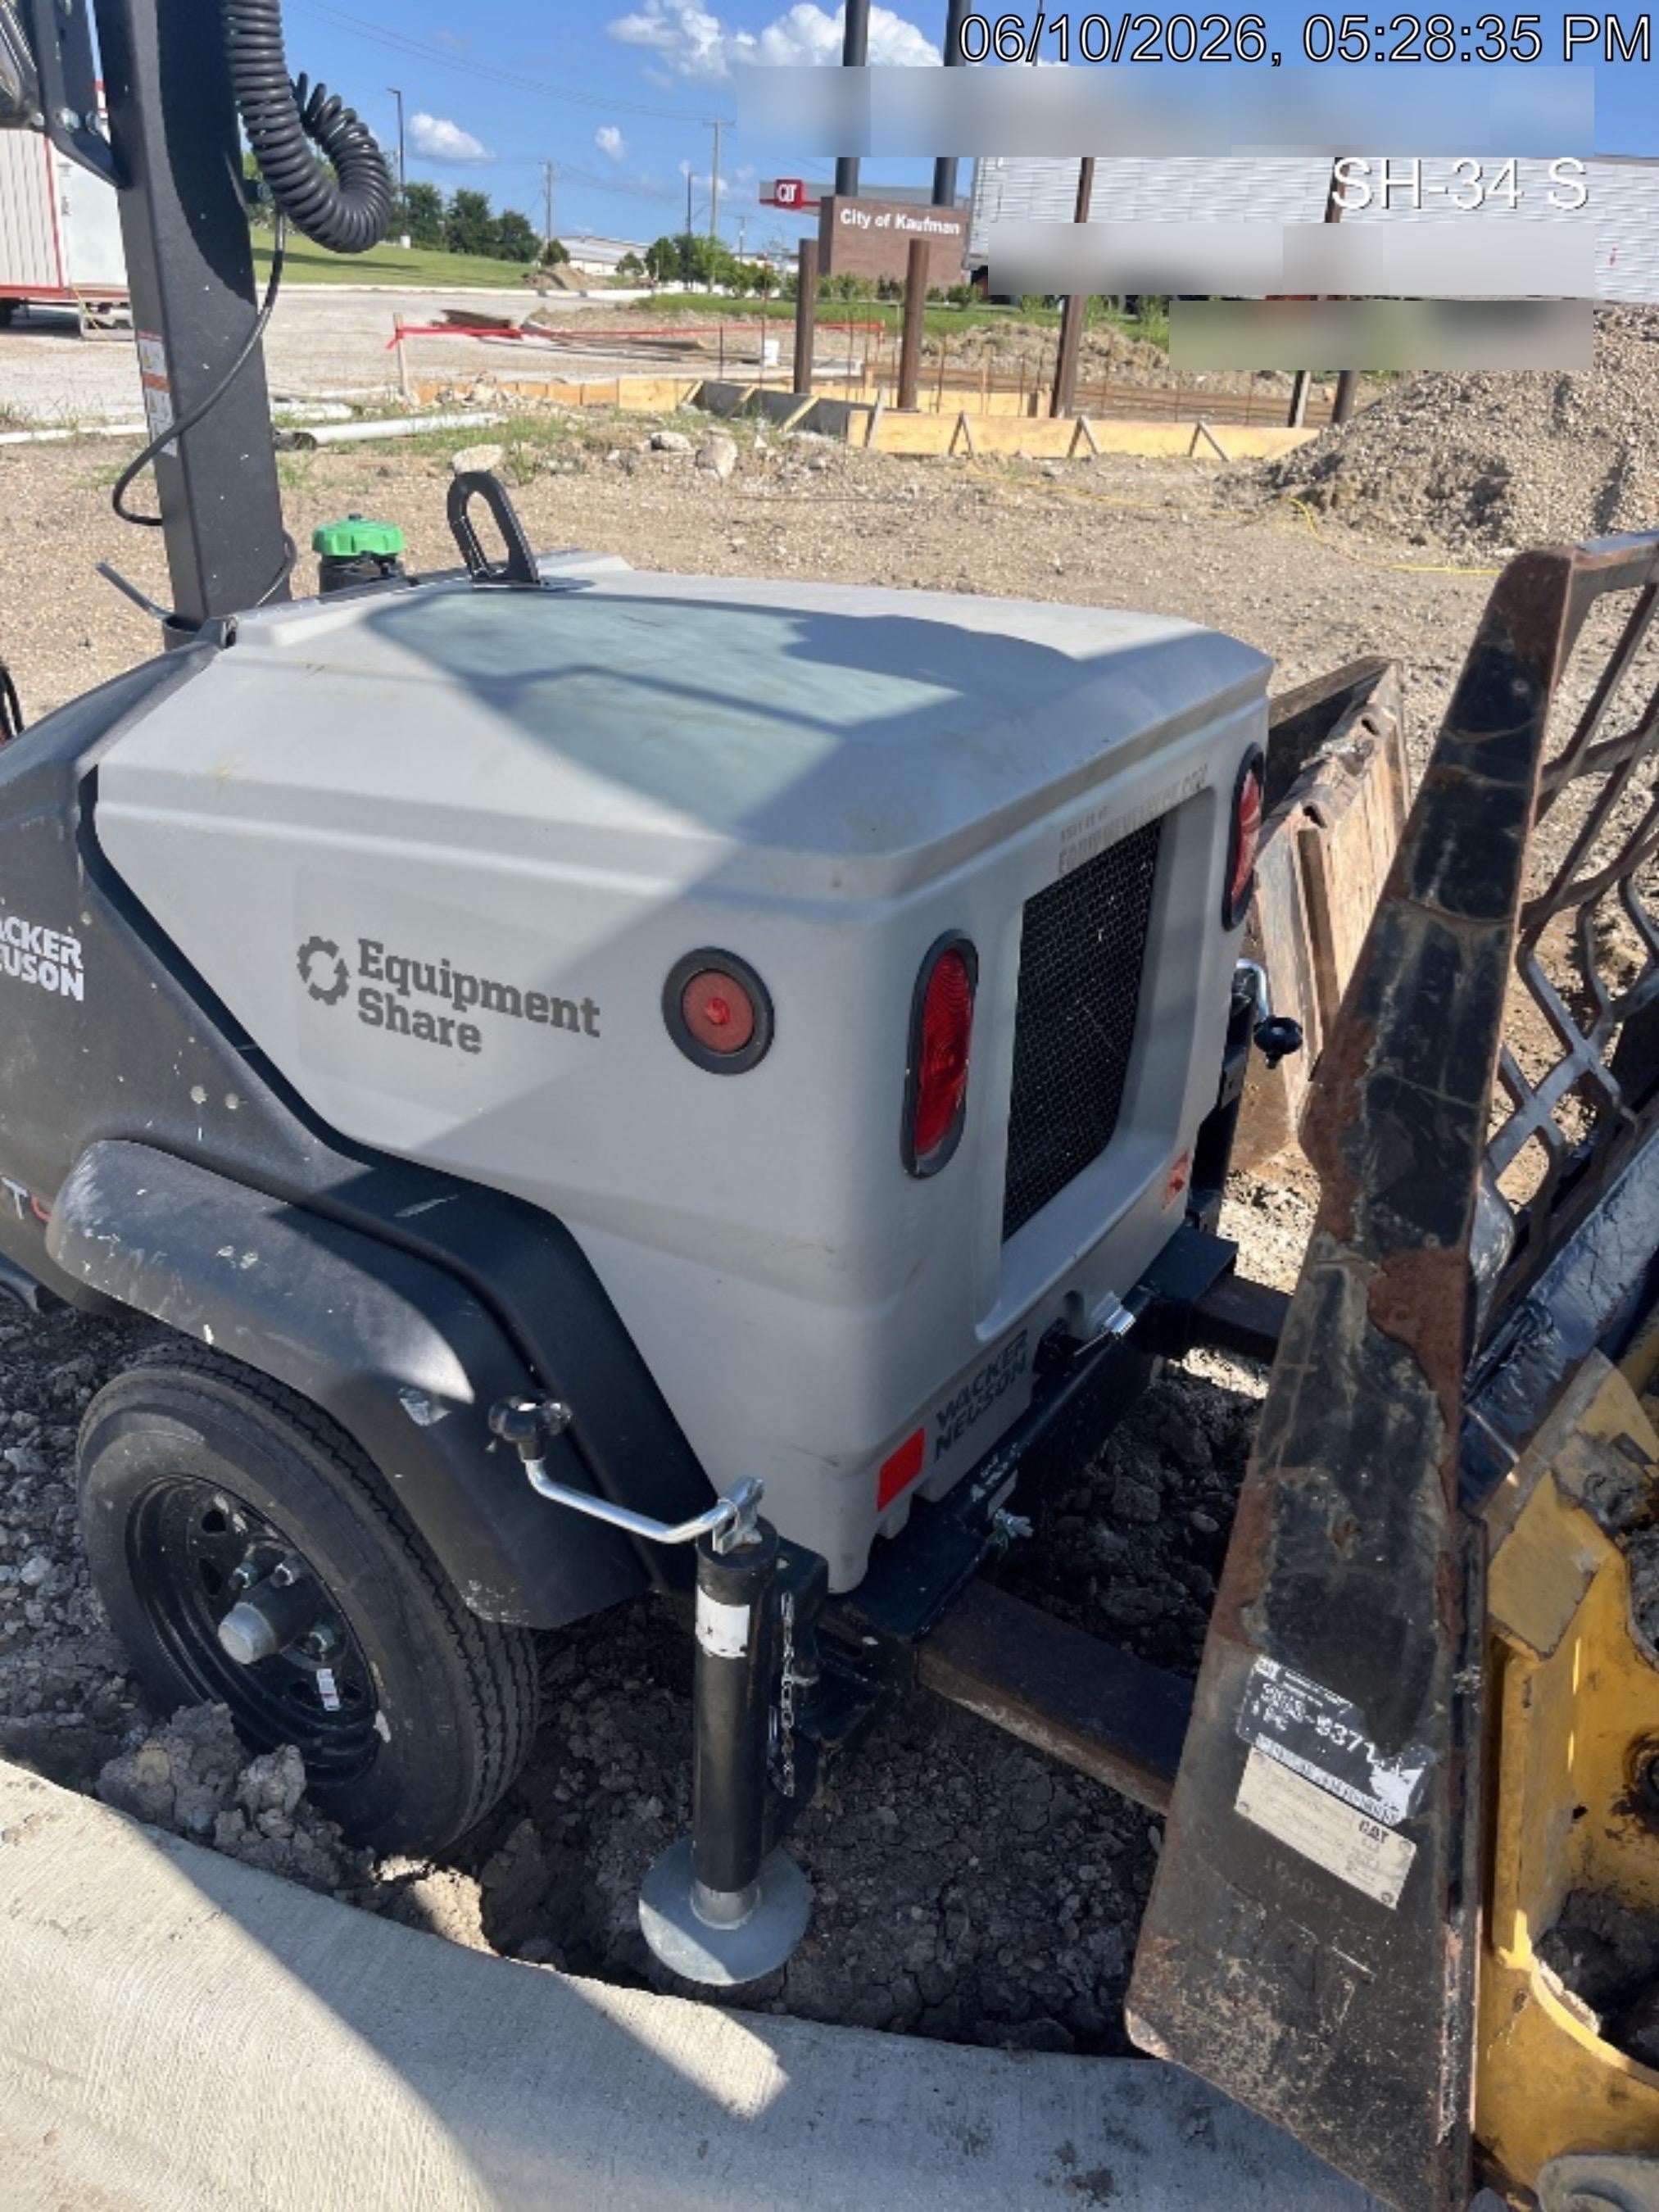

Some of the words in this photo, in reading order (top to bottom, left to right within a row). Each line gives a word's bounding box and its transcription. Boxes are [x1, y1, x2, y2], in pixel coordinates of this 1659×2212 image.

[841, 209, 870, 229] City
[875, 213, 891, 227] of
[895, 215, 959, 235] Kaufman
[0, 943, 84, 1001] USON
[358, 938, 600, 1037] Equipment
[358, 987, 482, 1054] Share
[934, 1351, 1026, 1463] NEUSON
[936, 1329, 1027, 1431] WACKER
[1359, 1820, 1389, 1843] CAT
